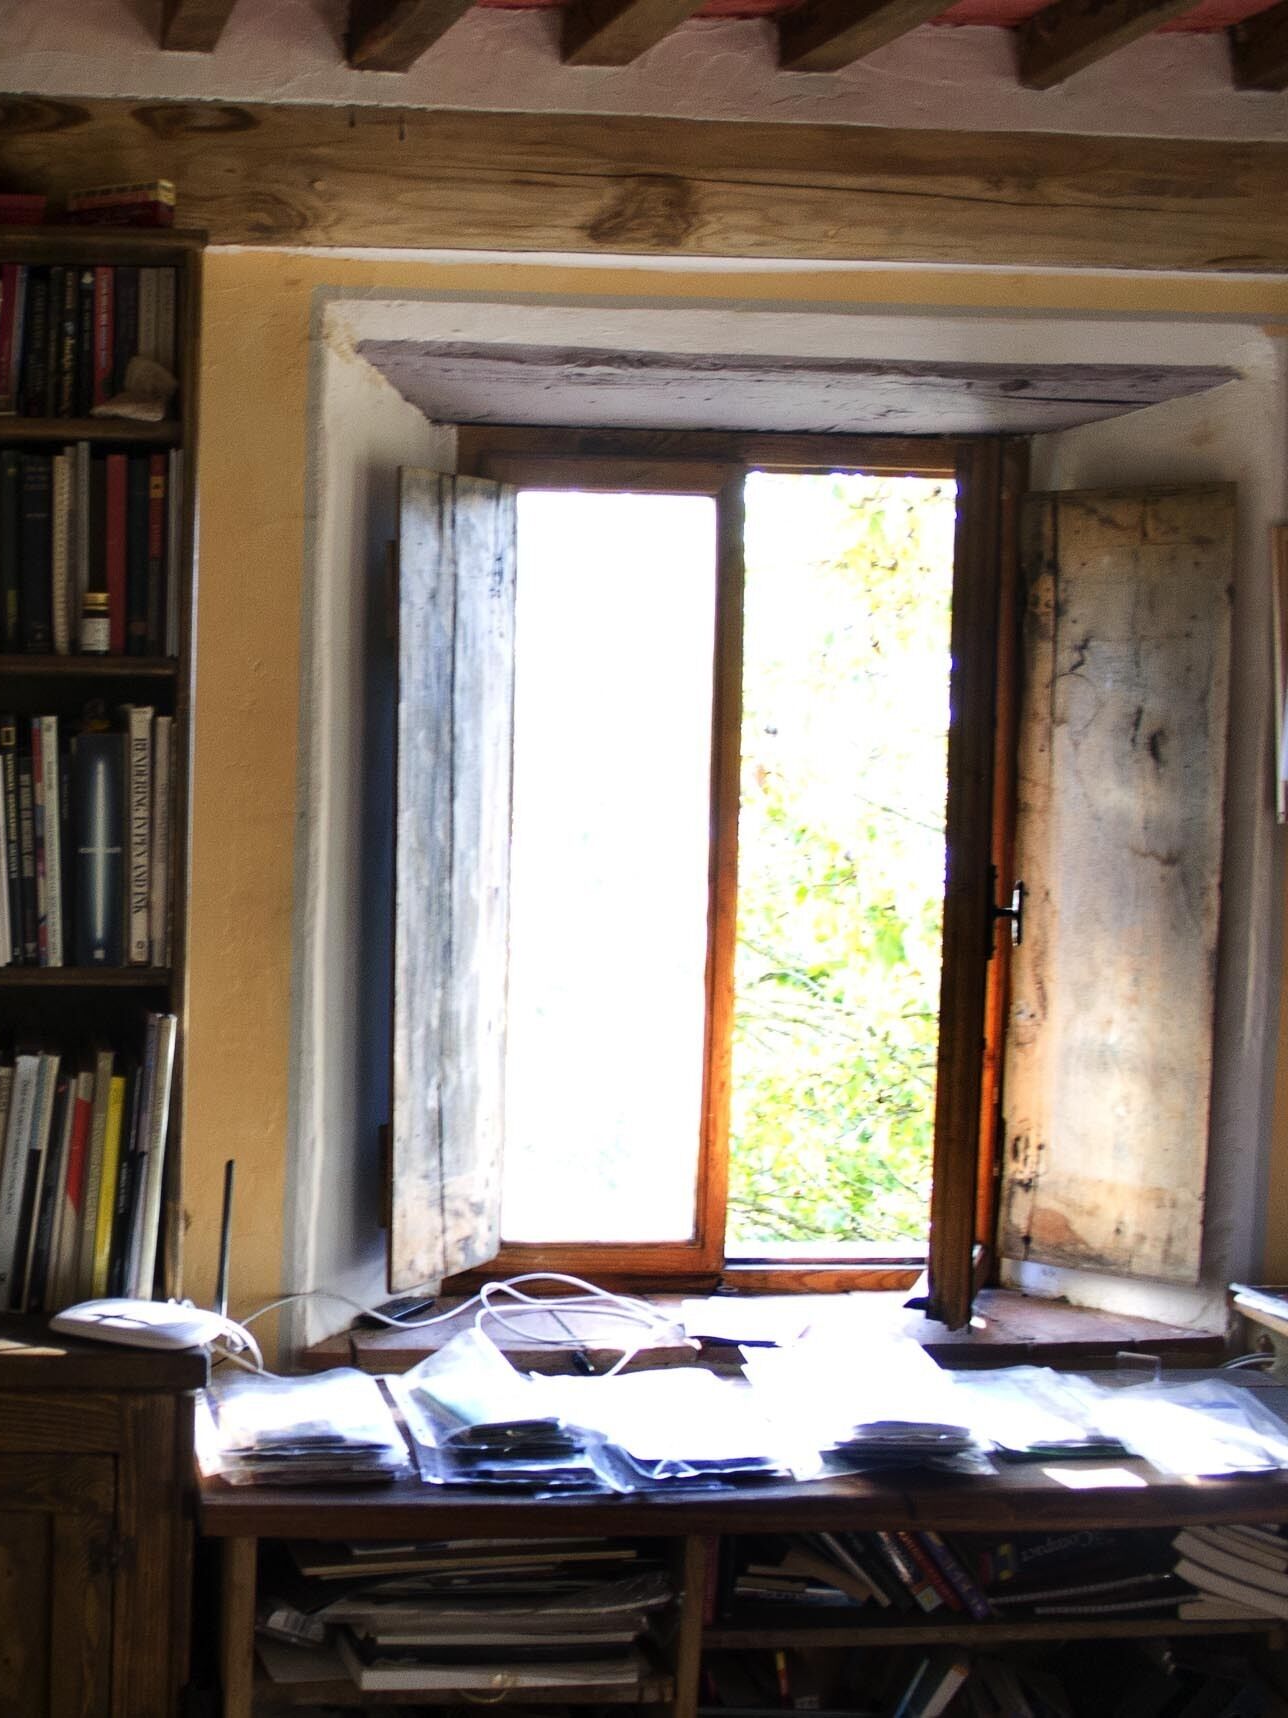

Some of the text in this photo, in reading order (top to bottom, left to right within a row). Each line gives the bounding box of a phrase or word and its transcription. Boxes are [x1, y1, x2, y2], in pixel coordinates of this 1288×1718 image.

[133, 738, 150, 915] RENDERING IN PEN AND INK
